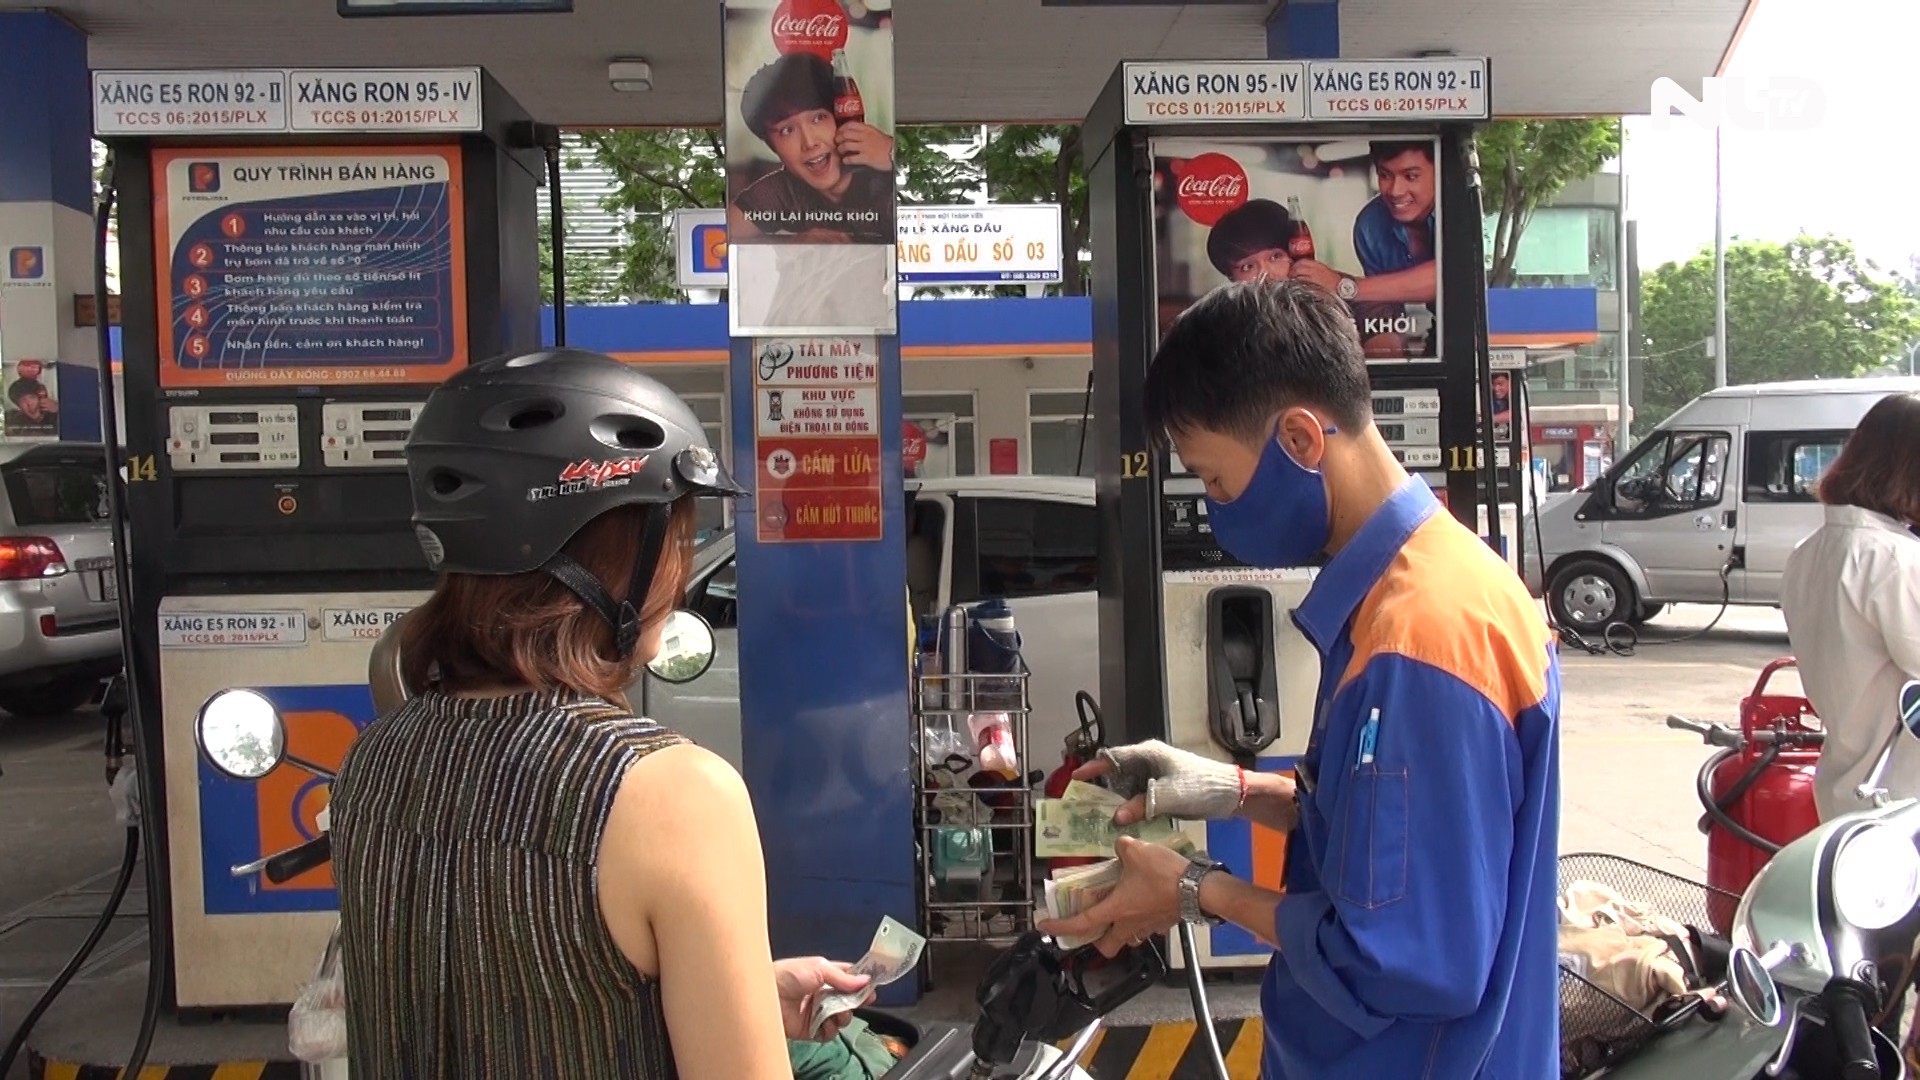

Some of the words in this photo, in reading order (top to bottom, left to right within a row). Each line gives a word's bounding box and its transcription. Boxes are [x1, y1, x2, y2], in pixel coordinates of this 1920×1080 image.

[774, 13, 843, 37] Coca-Cola
[1134, 71, 1190, 95] XĂNG
[1197, 74, 1240, 94] RON
[1313, 69, 1362, 92] XĂNG
[1369, 72, 1389, 91] E5
[1395, 72, 1432, 91] RON
[1438, 70, 1457, 89] 92
[100, 80, 153, 104] XĂNG
[160, 84, 182, 103] E5
[188, 83, 228, 103] RON
[235, 83, 255, 102] 92
[298, 79, 357, 103] XĂNG
[365, 83, 409, 102] RON
[1147, 102, 1188, 115] TCCS
[1194, 101, 1286, 114] 01:2015/PLX
[1328, 100, 1369, 111] TCCS
[1374, 97, 1468, 111] 06:2015/PLX
[116, 111, 161, 125] TCCS
[166, 110, 267, 125] 06:2015/PLX
[312, 111, 356, 124] TCCS
[362, 110, 459, 124] 01:2015/PLX
[233, 168, 273, 182] QUY
[277, 163, 333, 181] TRÌNH
[339, 163, 376, 181] BÁN
[383, 162, 435, 180] HÀNG
[1179, 174, 1244, 197] Coca-Cola
[346, 212, 367, 221] vào
[264, 227, 287, 235] nhu
[338, 226, 373, 235] khách
[932, 223, 970, 233] XĂNG
[973, 222, 1002, 233] DẦU
[224, 243, 263, 255] Thông
[291, 243, 328, 252] khách
[331, 242, 362, 253] hàng
[898, 240, 931, 263] ĂNG
[944, 236, 978, 263] DẦU
[992, 235, 1014, 261] SỐ
[1026, 241, 1045, 261] 03
[257, 274, 290, 285] hàng
[313, 272, 341, 282] theo
[224, 288, 265, 297] khách
[267, 287, 300, 298] hàng
[227, 304, 267, 315] Thông
[296, 302, 334, 312] khách
[337, 302, 369, 313] hàng
[405, 302, 423, 311] tra
[324, 316, 345, 325] khi
[347, 316, 384, 325] thanh
[1364, 313, 1417, 334] KHỞI
[345, 338, 385, 347] khách
[388, 338, 425, 349] hàng!
[799, 338, 824, 357] TẮT
[829, 340, 861, 357] MÁY
[787, 364, 838, 379] PHƯƠNG
[843, 362, 874, 381] TIỆN
[802, 390, 826, 401] KHU
[831, 387, 856, 403] VỰC
[793, 406, 823, 419] KHÔNG
[840, 408, 865, 420] DỤNG
[780, 421, 801, 434] ĐIỆN
[804, 422, 830, 435] THOẠI
[833, 422, 842, 432] DI
[845, 420, 869, 434] ĐỘNG
[802, 447, 835, 475] CẤM
[843, 446, 872, 474] LỬA
[1121, 451, 1149, 479] 12
[1449, 445, 1476, 472] 11
[128, 454, 158, 482] 14
[796, 500, 819, 525] CẤM
[822, 502, 841, 524] HÚT
[846, 501, 878, 525] THUỐC
[164, 616, 203, 632] XĂNG
[207, 618, 224, 631] E5
[227, 617, 257, 630] RON
[261, 617, 277, 630] 92
[333, 609, 378, 626] XĂNG
[180, 634, 210, 643] TCCS
